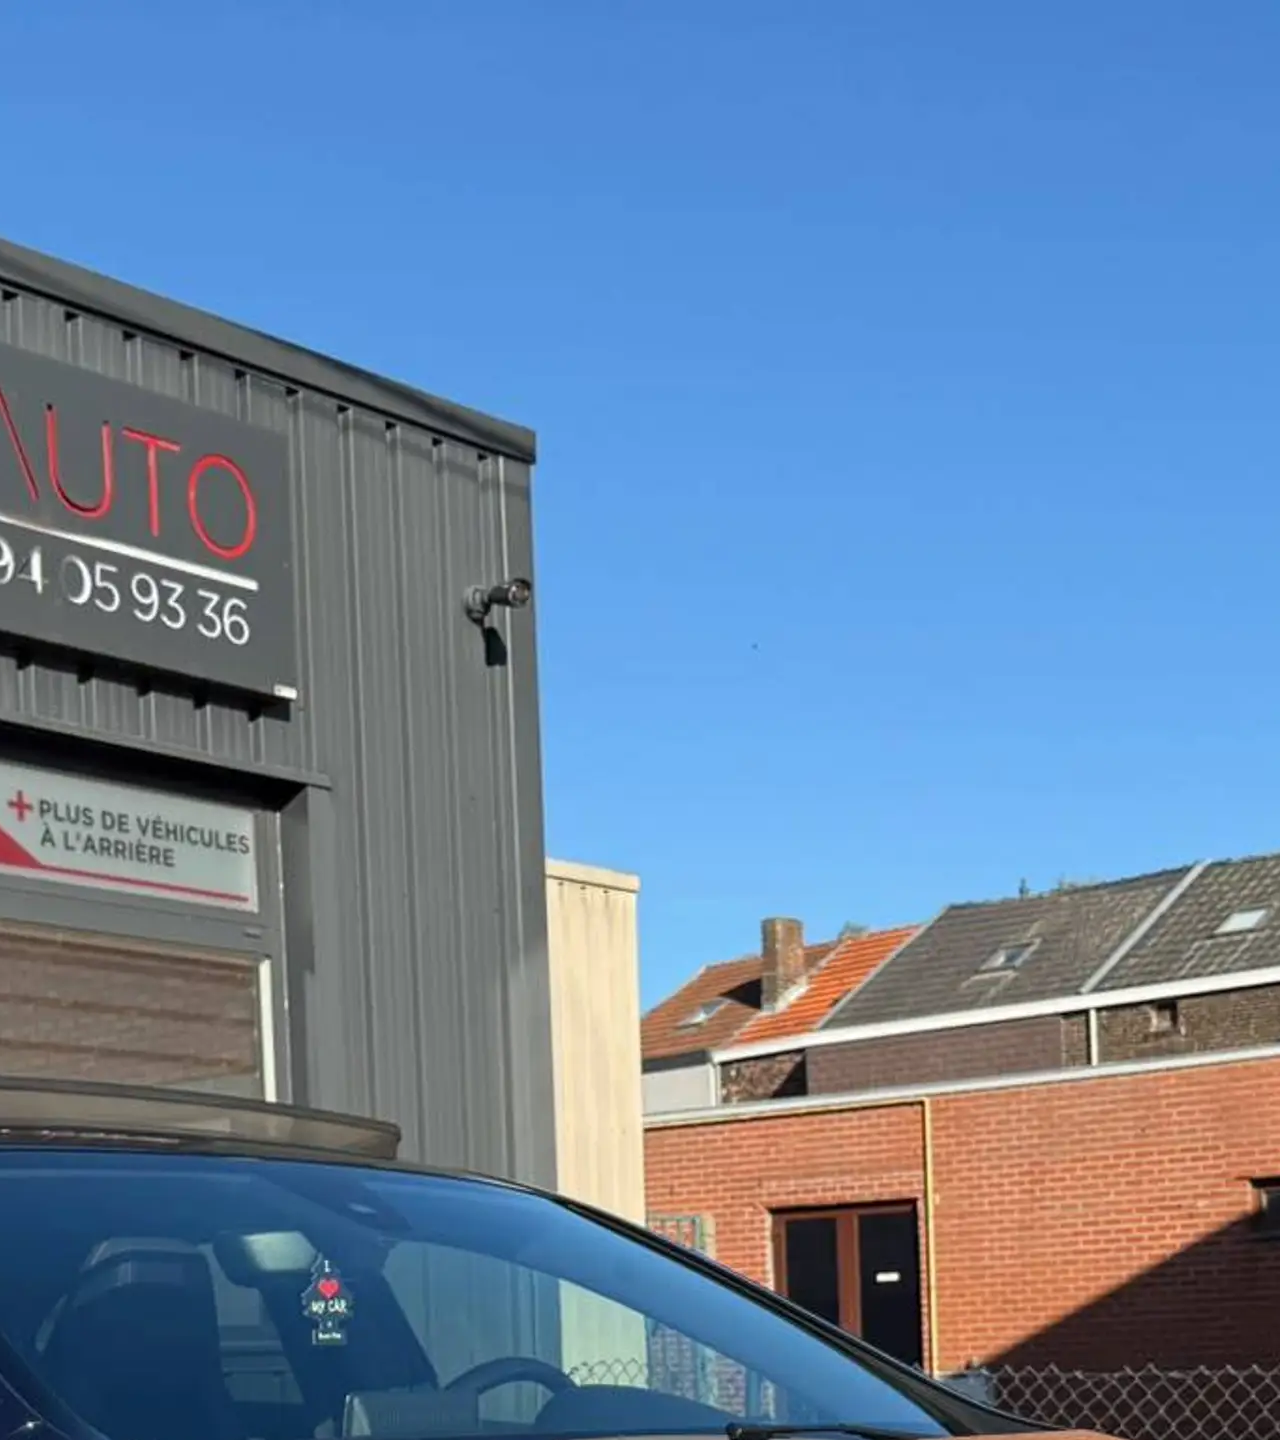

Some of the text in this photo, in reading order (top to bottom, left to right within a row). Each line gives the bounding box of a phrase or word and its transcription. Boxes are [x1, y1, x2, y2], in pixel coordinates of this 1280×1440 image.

[60, 554, 122, 613] 05
[130, 572, 187, 630] 93
[196, 588, 251, 646] 36
[39, 798, 250, 855] PLUS DE VÉHICULES
[40, 821, 56, 848] À
